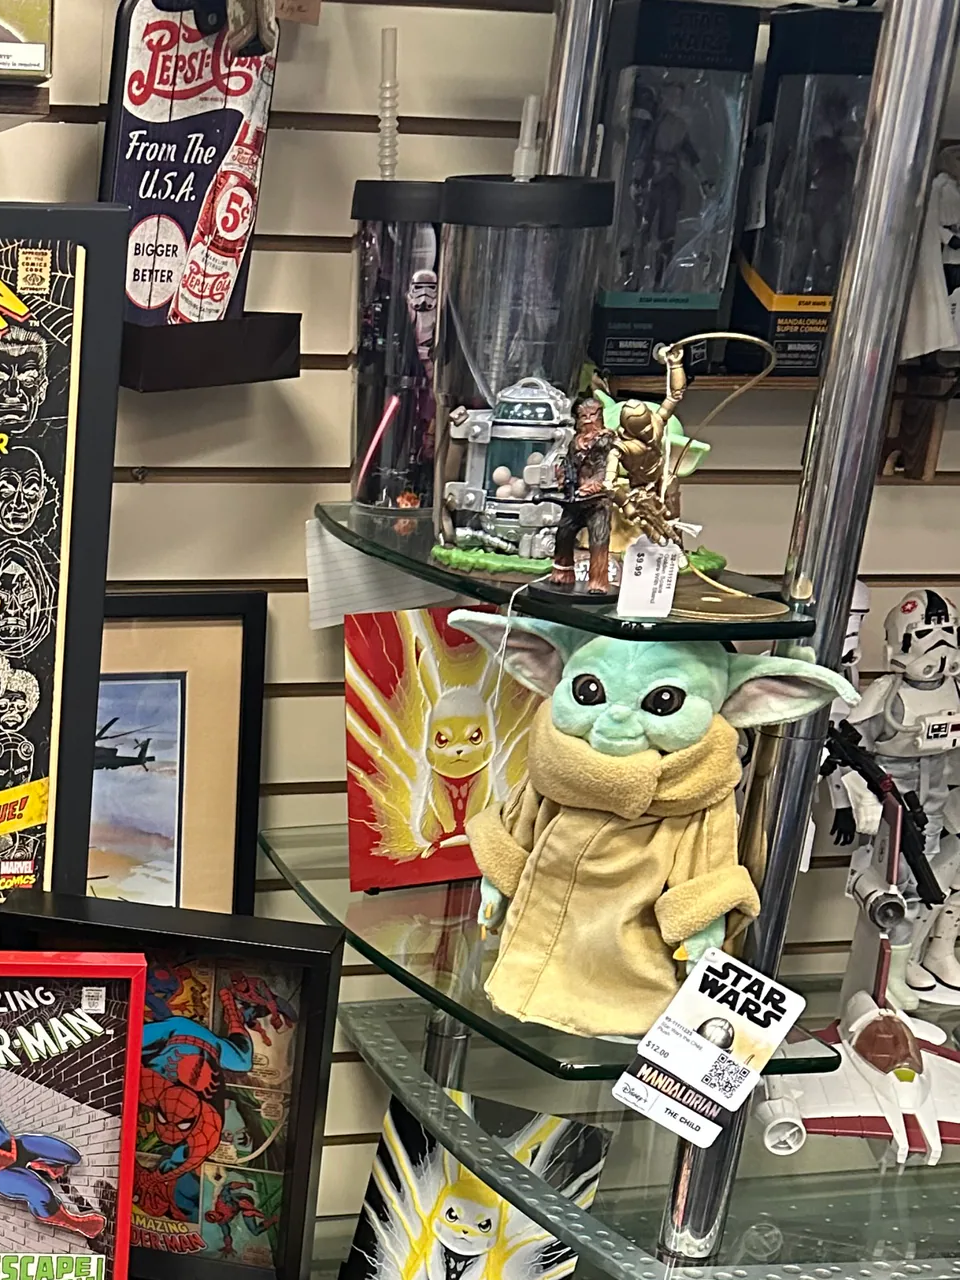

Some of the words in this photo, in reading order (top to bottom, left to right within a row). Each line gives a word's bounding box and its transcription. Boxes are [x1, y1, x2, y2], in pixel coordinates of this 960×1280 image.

[126, 130, 177, 163] From
[183, 133, 217, 164] The
[139, 170, 196, 202] U.S.A.
[134, 243, 178, 258] BIGGER
[133, 268, 173, 283] BETTER
[776, 318, 828, 327] MANDALORIAN
[776, 325, 794, 333] SUPER
[634, 552, 645, 577] $9.99
[0, 861, 33, 875] MARVEL
[704, 961, 787, 1015] STAR
[698, 974, 783, 1029] WARS
[645, 1040, 670, 1059] $12.00
[636, 1062, 721, 1121] MANDALORIAN
[664, 1107, 679, 1120] THE
[679, 1116, 702, 1133] CHILD
